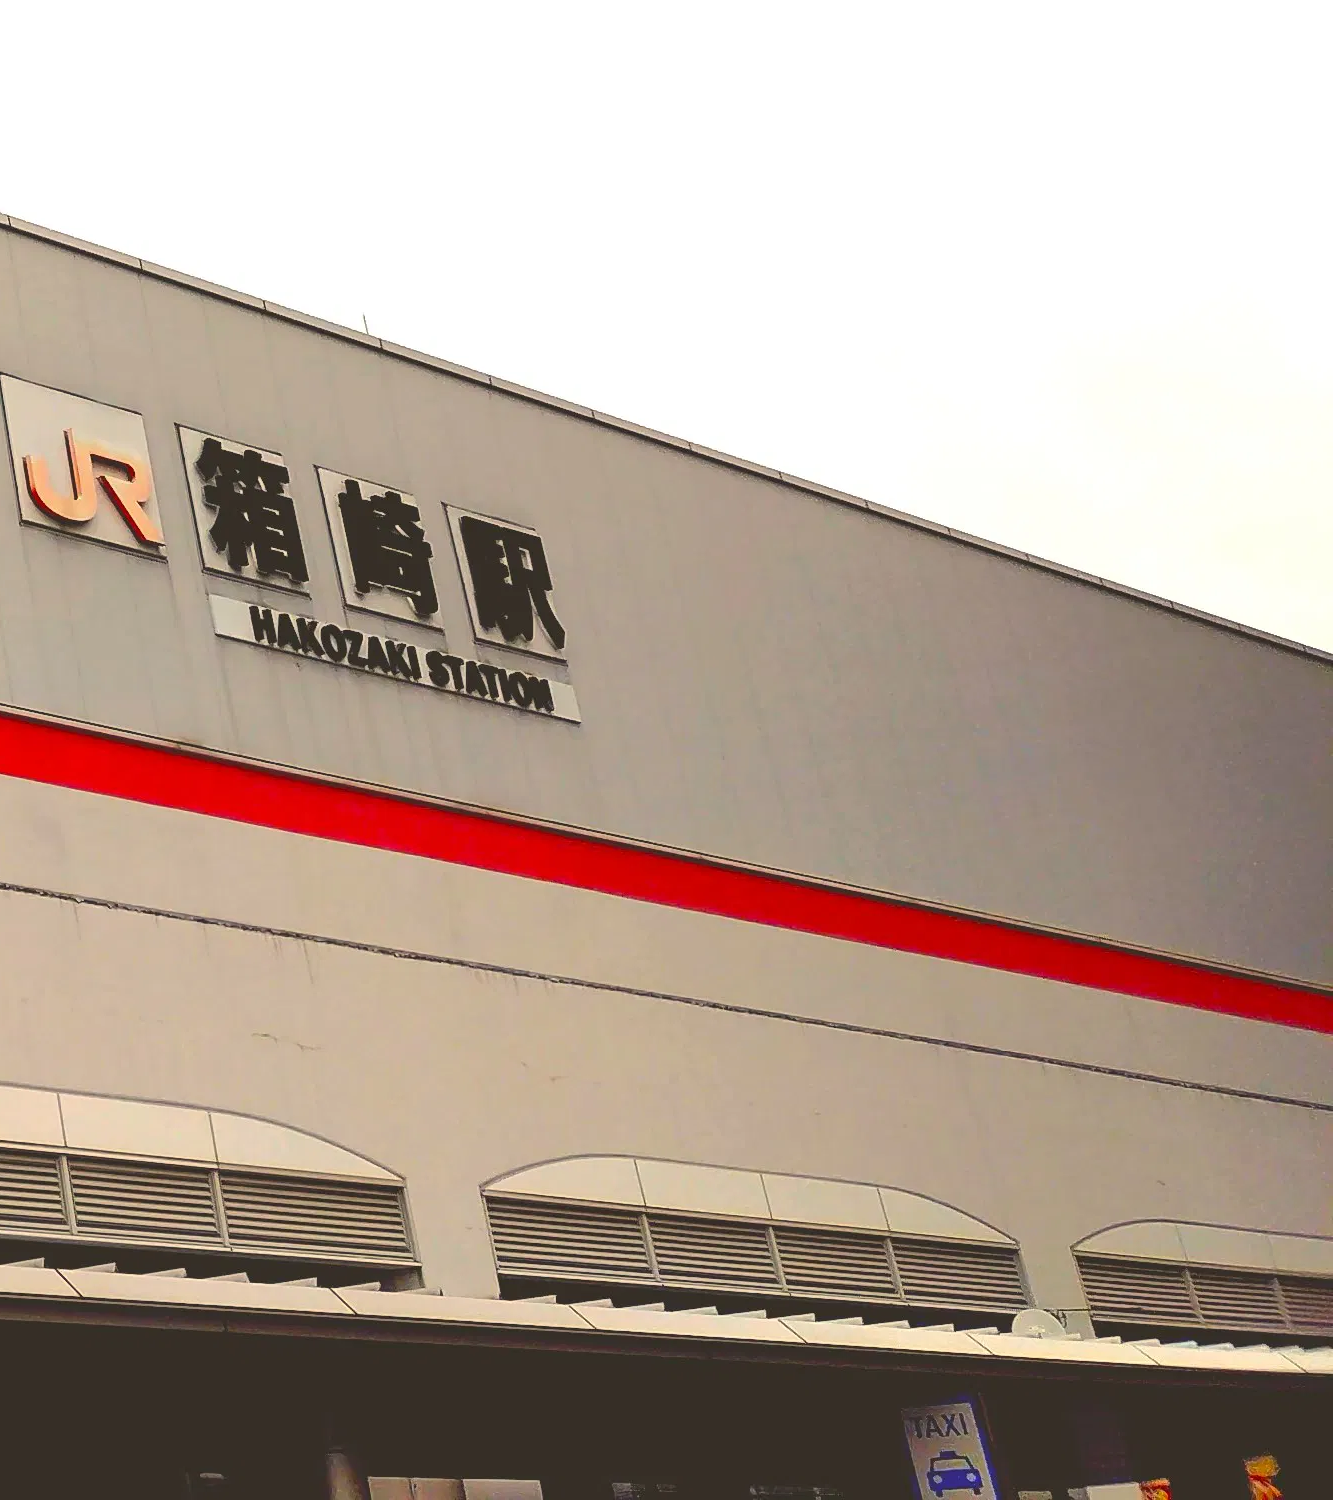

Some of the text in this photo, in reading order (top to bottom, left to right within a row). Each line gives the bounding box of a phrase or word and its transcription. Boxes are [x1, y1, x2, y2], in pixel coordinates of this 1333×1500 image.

[22, 428, 165, 547] JR
[196, 437, 565, 649] 箱崎駅
[249, 605, 555, 712] HAKOZAKI STATION
[910, 1412, 969, 1440] TAXI
